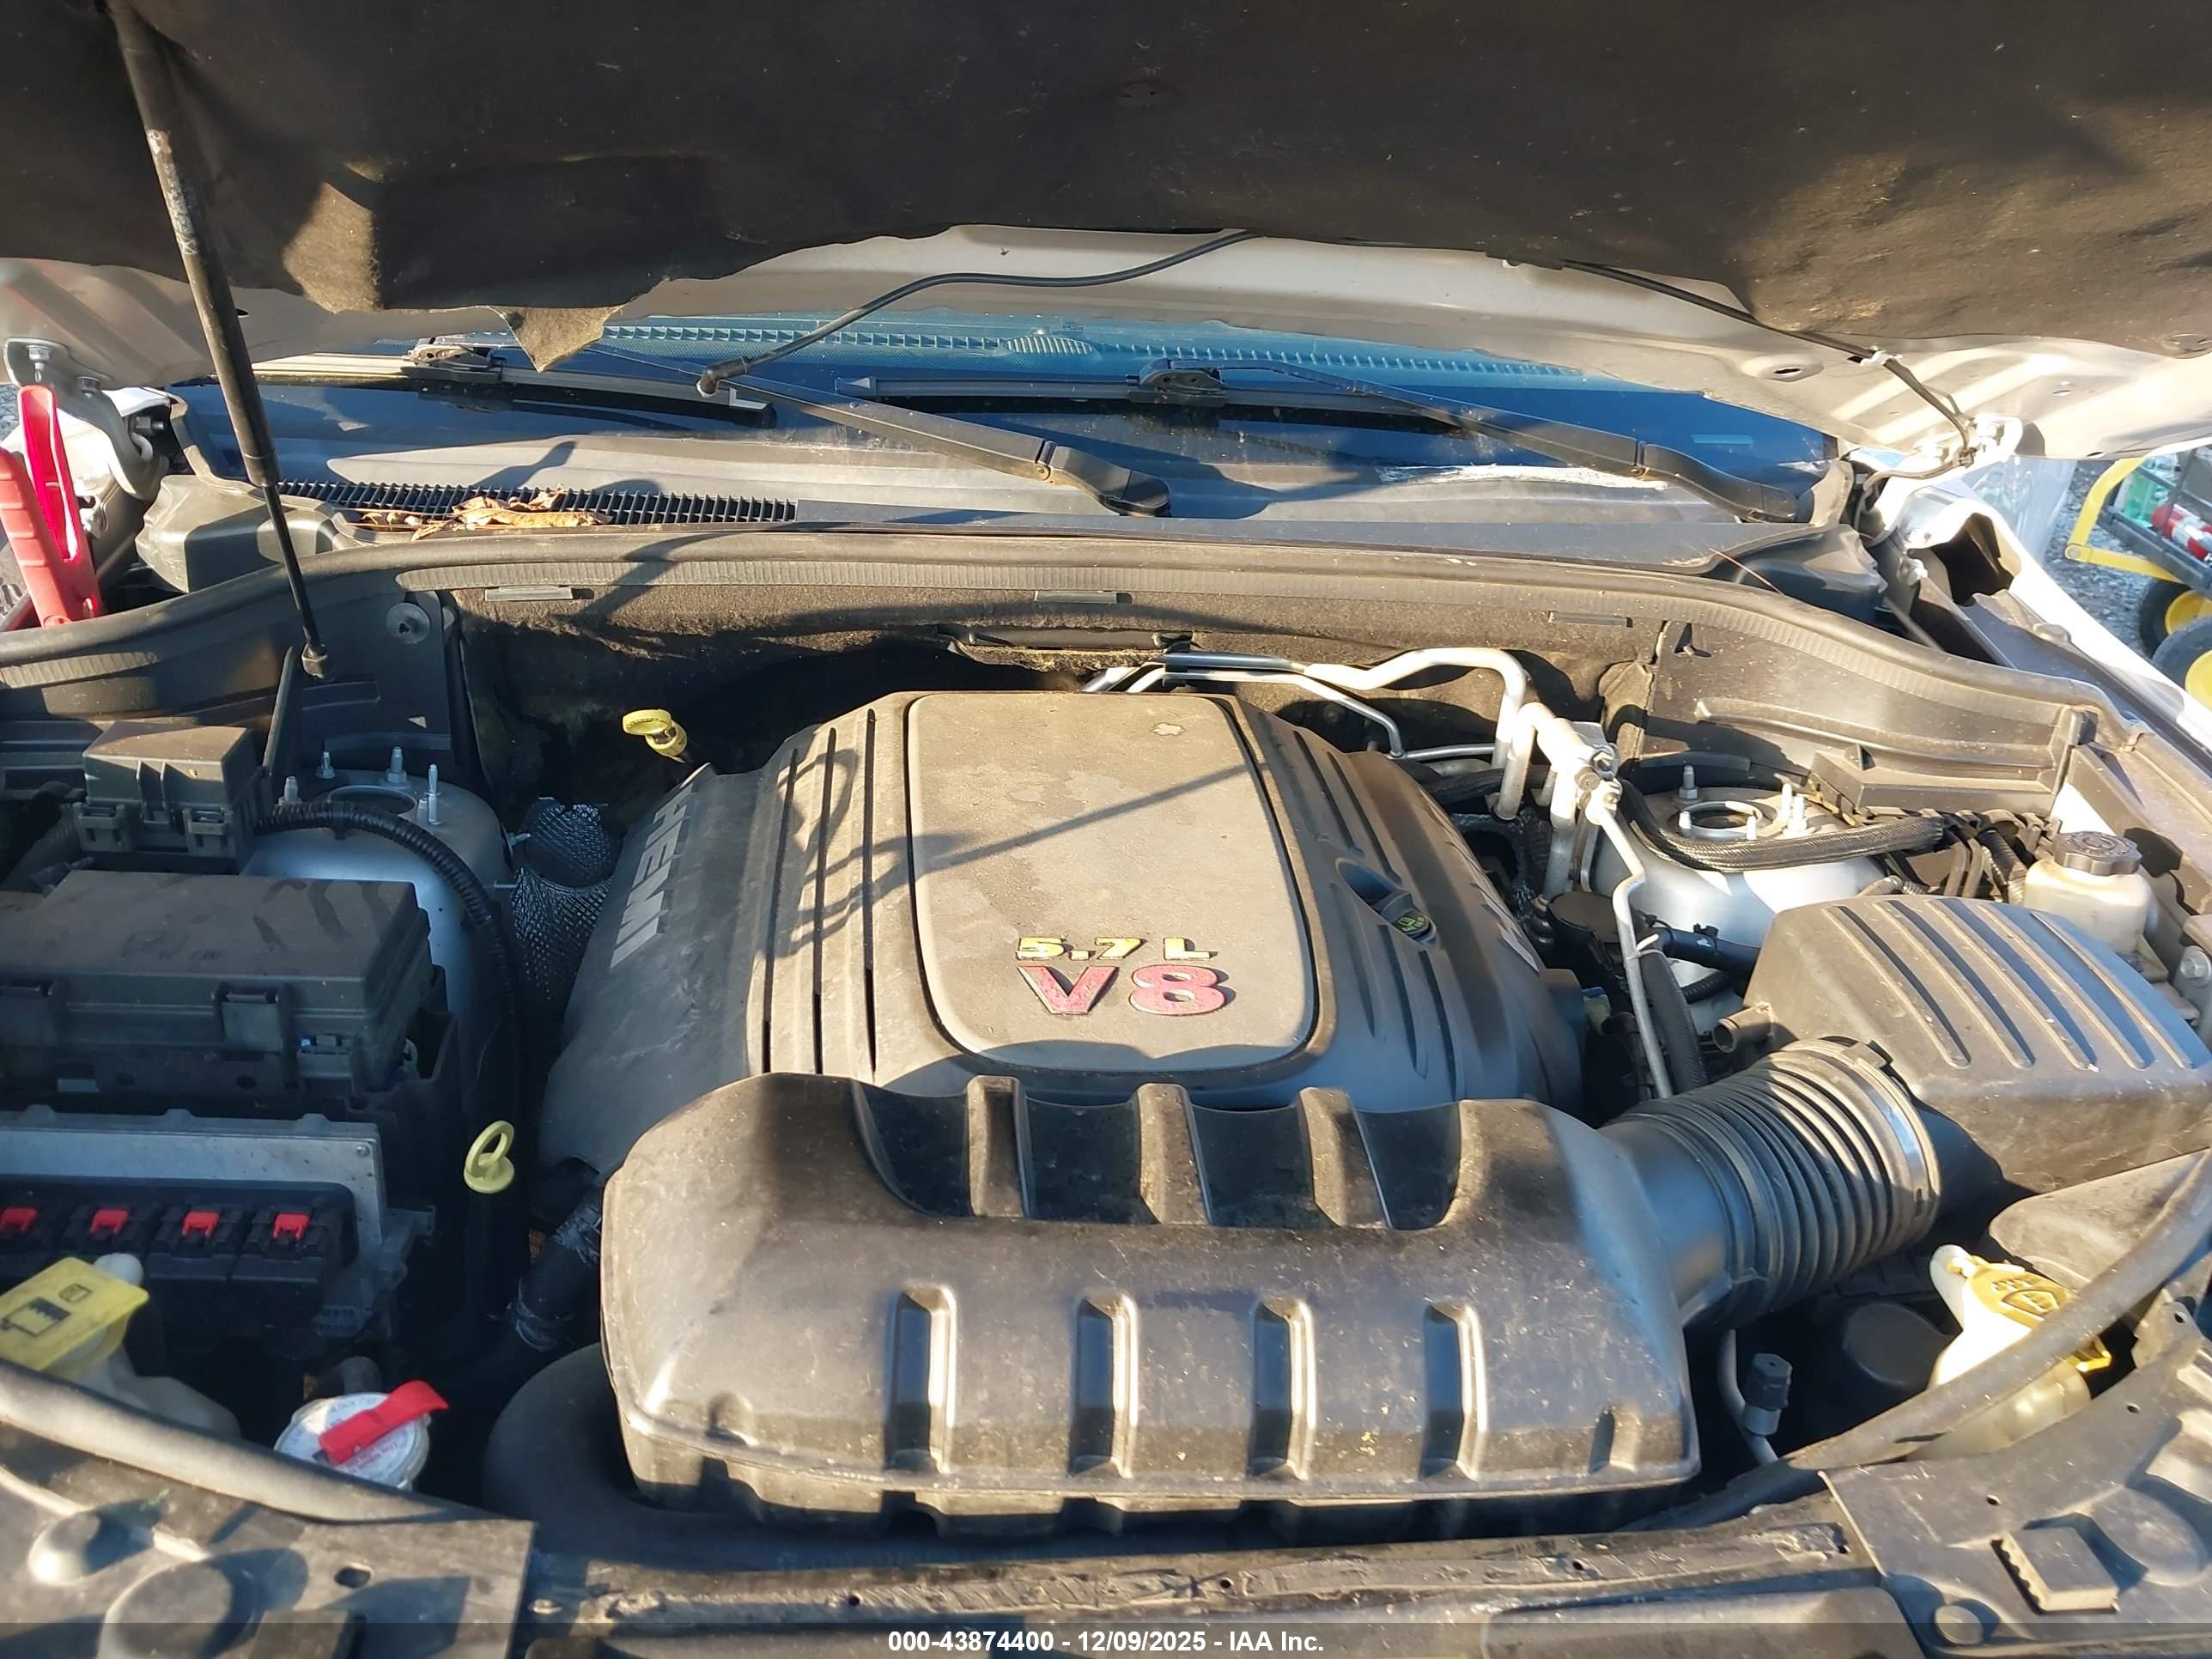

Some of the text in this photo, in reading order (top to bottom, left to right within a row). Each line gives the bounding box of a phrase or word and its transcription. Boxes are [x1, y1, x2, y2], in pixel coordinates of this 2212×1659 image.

[610, 782, 694, 969] HEMI
[1016, 936, 1212, 961] 5.7 L
[1017, 963, 1229, 1016] V8
